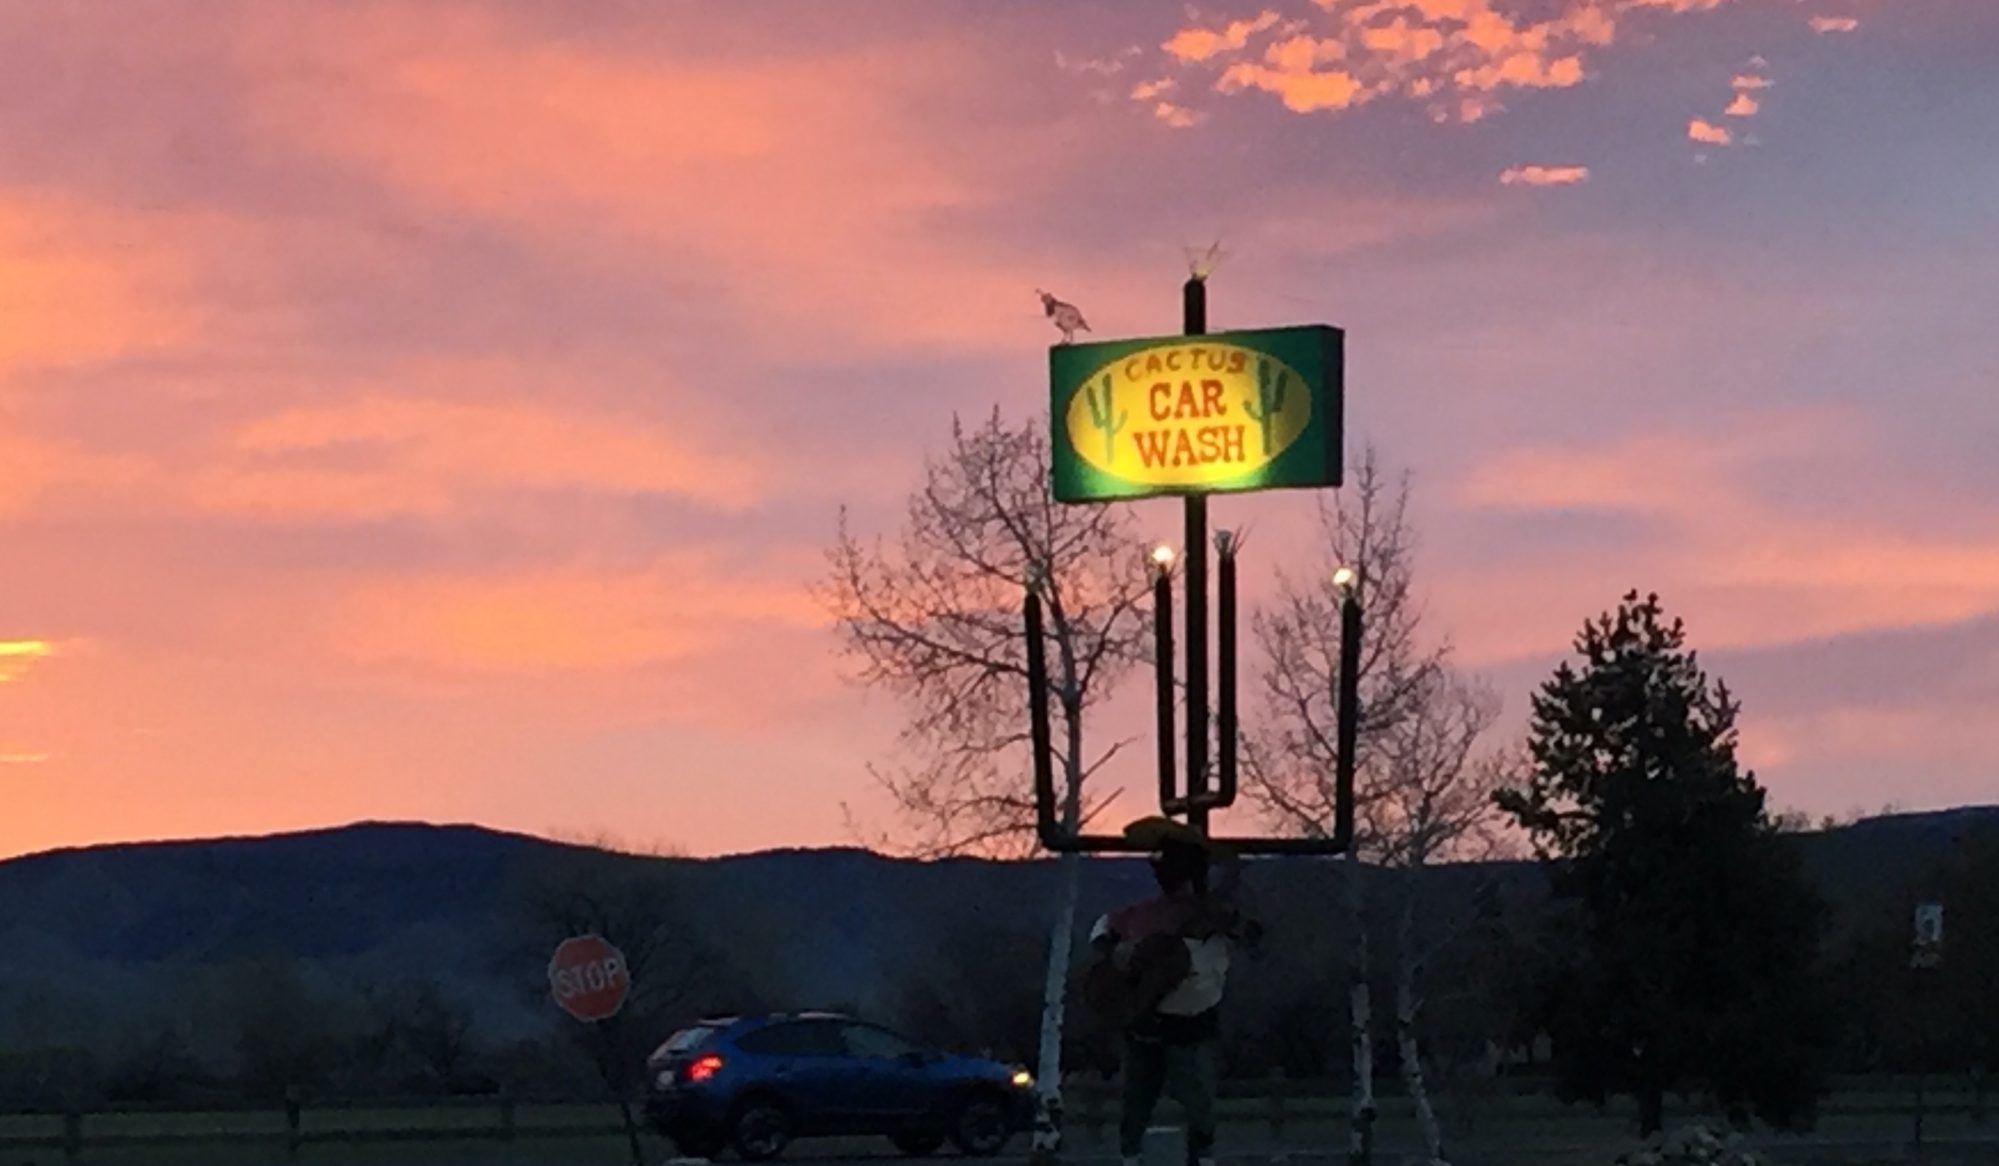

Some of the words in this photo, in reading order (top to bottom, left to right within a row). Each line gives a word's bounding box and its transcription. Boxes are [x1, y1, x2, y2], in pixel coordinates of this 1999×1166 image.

[1125, 348, 1248, 381] CACTUS
[1149, 379, 1227, 421] CAR
[1133, 425, 1246, 468] WASH
[556, 958, 618, 998] STOP
